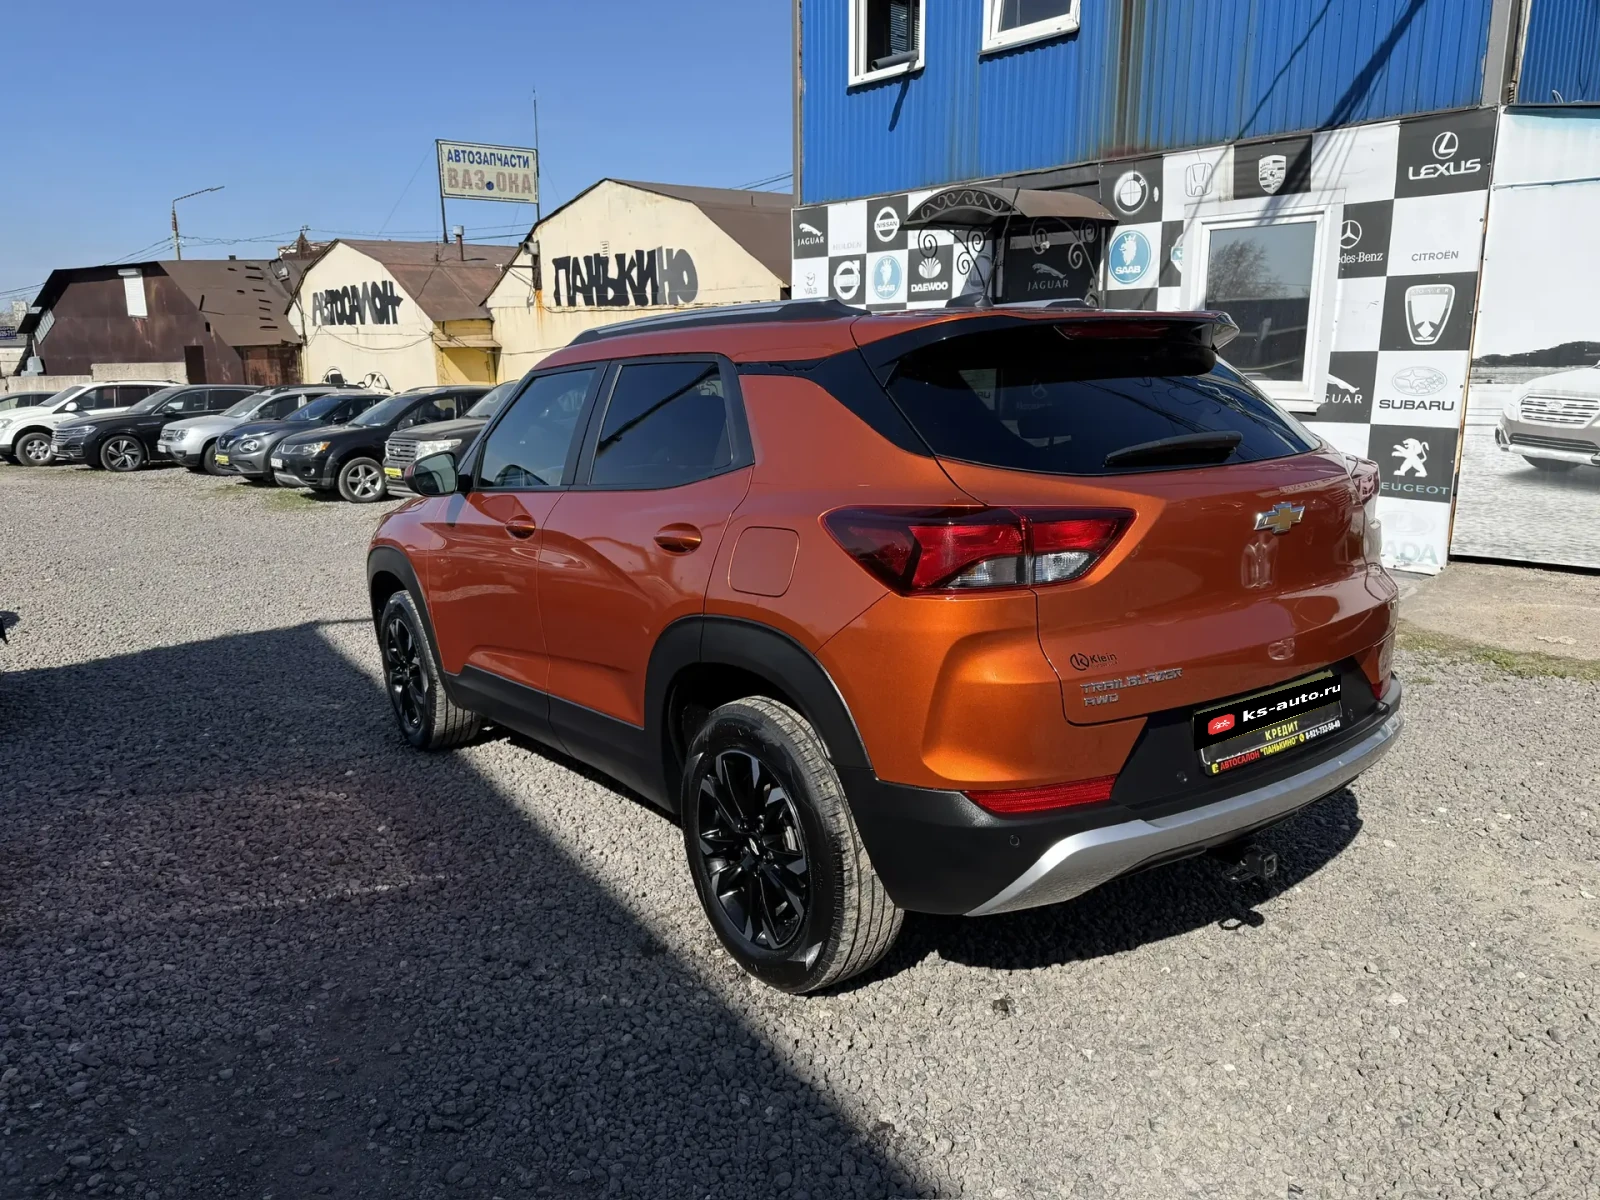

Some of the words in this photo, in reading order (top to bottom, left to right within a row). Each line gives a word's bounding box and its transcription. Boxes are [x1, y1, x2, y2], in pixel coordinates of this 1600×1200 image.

[447, 149, 530, 168] АВТОЗАПЧАСТИ
[1408, 158, 1481, 180] LEXUS
[447, 167, 486, 190] ВАЗ
[876, 220, 898, 229] NISSAN
[797, 236, 825, 247] JAGUAR
[1411, 250, 1459, 262] CITROËN
[552, 246, 698, 307] ПАНЬКИНО
[1115, 265, 1141, 275] SAAB
[911, 281, 949, 293] DAEWOO
[1027, 279, 1069, 292] JAGUAR
[312, 280, 401, 326] АВТОСАЛОН
[1379, 399, 1455, 412] SUBARU
[1381, 482, 1450, 495] EUGEOT
[1383, 540, 1439, 565] ADA
[1089, 652, 1118, 664] Klein
[1080, 667, 1183, 693] TRAILBLAZER
[1083, 693, 1119, 707] AWD
[1264, 720, 1299, 741] КРЕДИТ
[1220, 750, 1260, 771] АВТОСАЛОН
